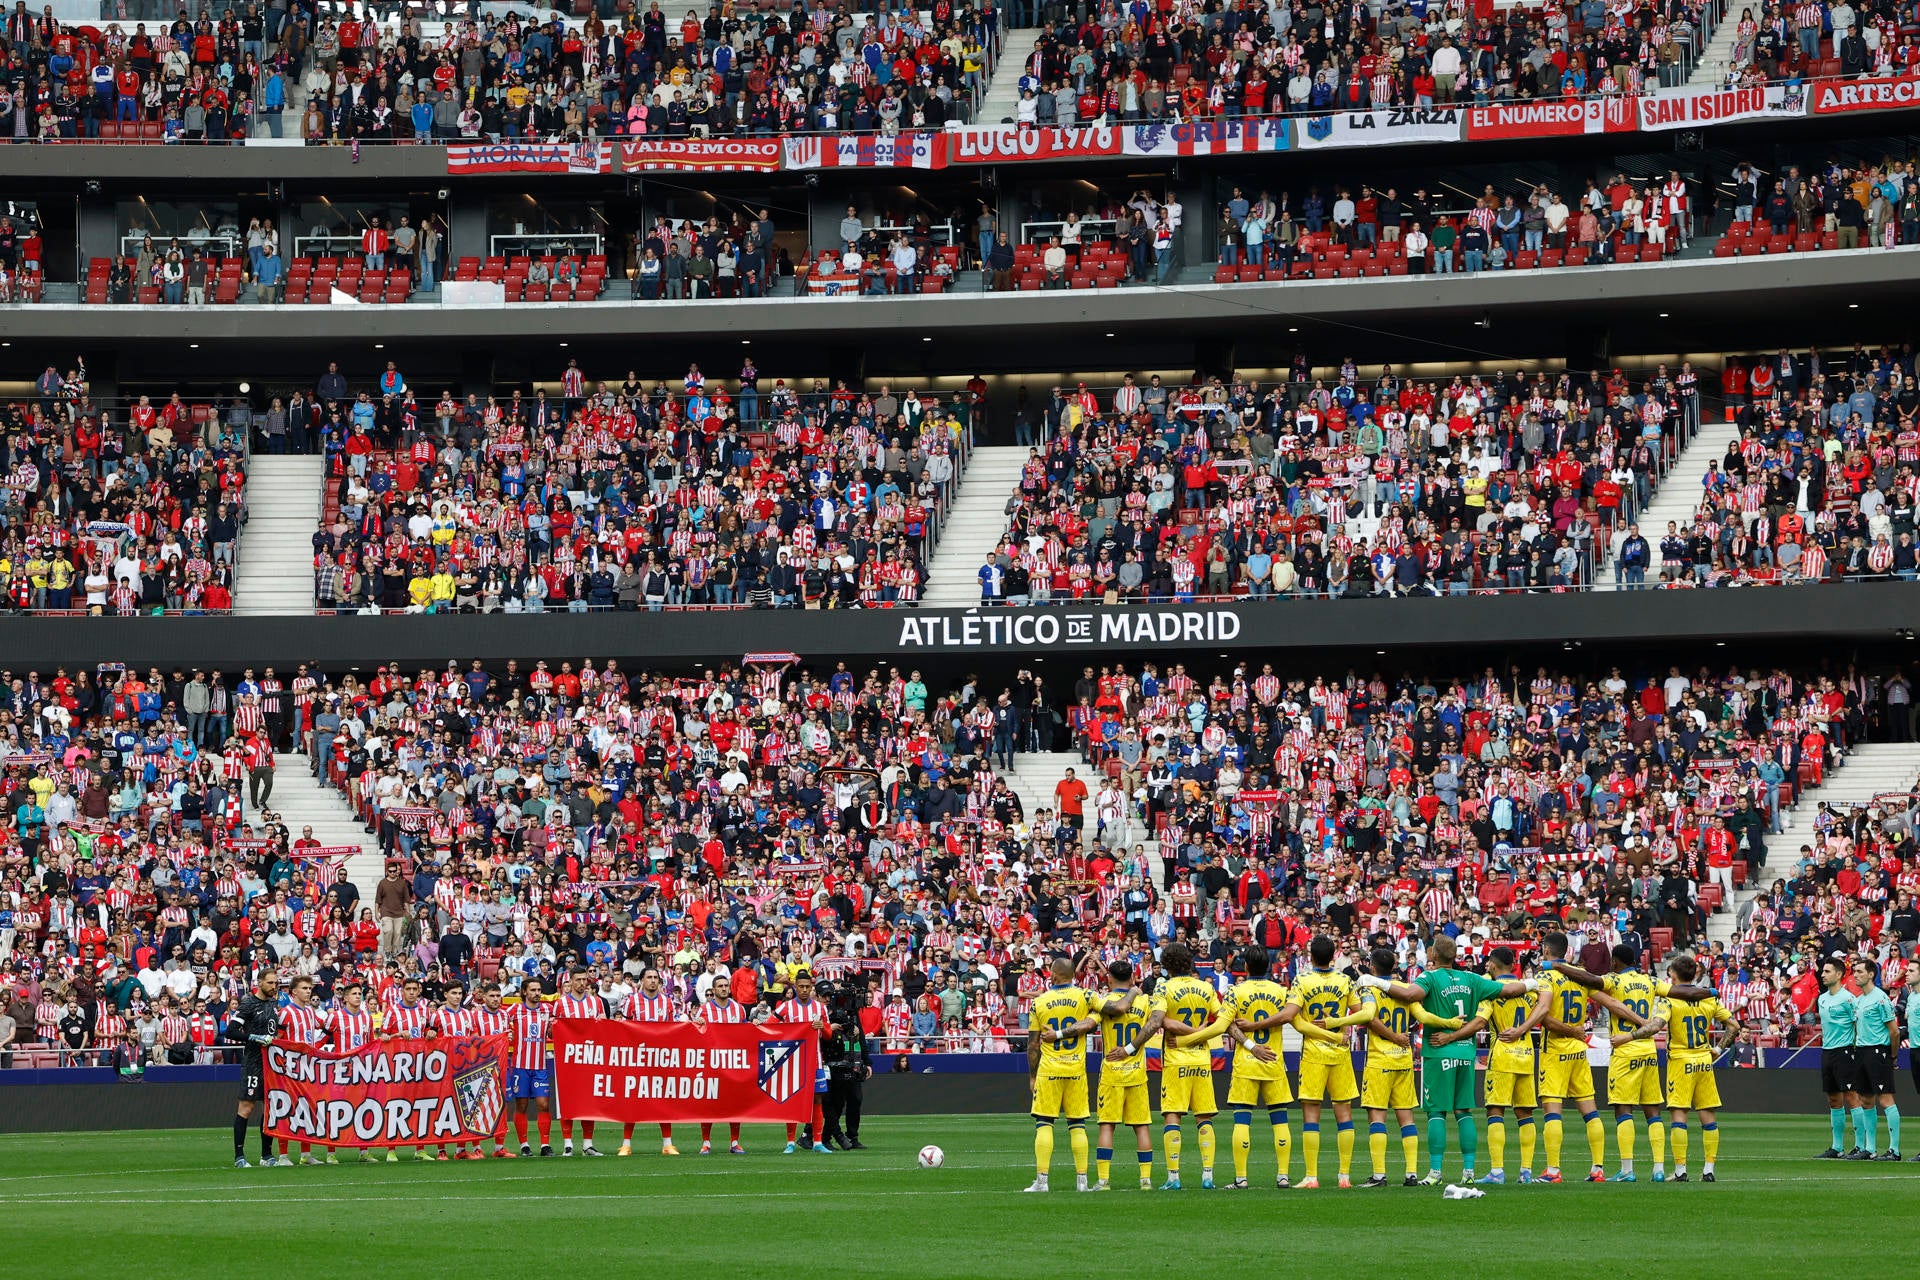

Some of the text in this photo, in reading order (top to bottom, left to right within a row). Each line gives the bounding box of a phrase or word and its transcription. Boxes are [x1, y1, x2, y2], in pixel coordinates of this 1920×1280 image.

[1349, 109, 1457, 129] LA ZARZA
[1473, 103, 1600, 127] EL NUMERO 3
[1644, 88, 1765, 125] SAN ISIDRO
[959, 126, 1113, 156] LUGO 1978
[1171, 119, 1285, 142] GRIFFA
[468, 145, 563, 164] MORALA
[623, 141, 778, 155] VALDEMORO
[835, 144, 926, 157] VALMOJADO
[899, 608, 1241, 646] ATLÉTICO DE MADRID
[575, 913, 599, 922] ATM
[1046, 998, 1078, 1010] SANDRO
[1190, 986, 1211, 1003] SILVA
[1303, 985, 1322, 1003] ALEX
[1560, 990, 1583, 1024] 15
[1309, 1001, 1340, 1033] 23
[1379, 1006, 1407, 1040] 20
[1454, 999, 1464, 1023] 1
[1513, 1006, 1525, 1041] 4
[1047, 1016, 1079, 1051] 19
[1112, 1022, 1142, 1056] 10
[1253, 1009, 1270, 1045] 8
[1682, 1015, 1708, 1049] 18
[267, 1045, 447, 1085] CENTENARIO
[564, 1040, 750, 1069] PEÑA ATLÉTICA DE UTIEL
[247, 1075, 258, 1088] 13
[513, 1075, 519, 1086] 7
[1178, 1067, 1210, 1078] Binter
[593, 1073, 719, 1100] EL PARADÓN
[267, 1089, 461, 1140] PAIPORTA
